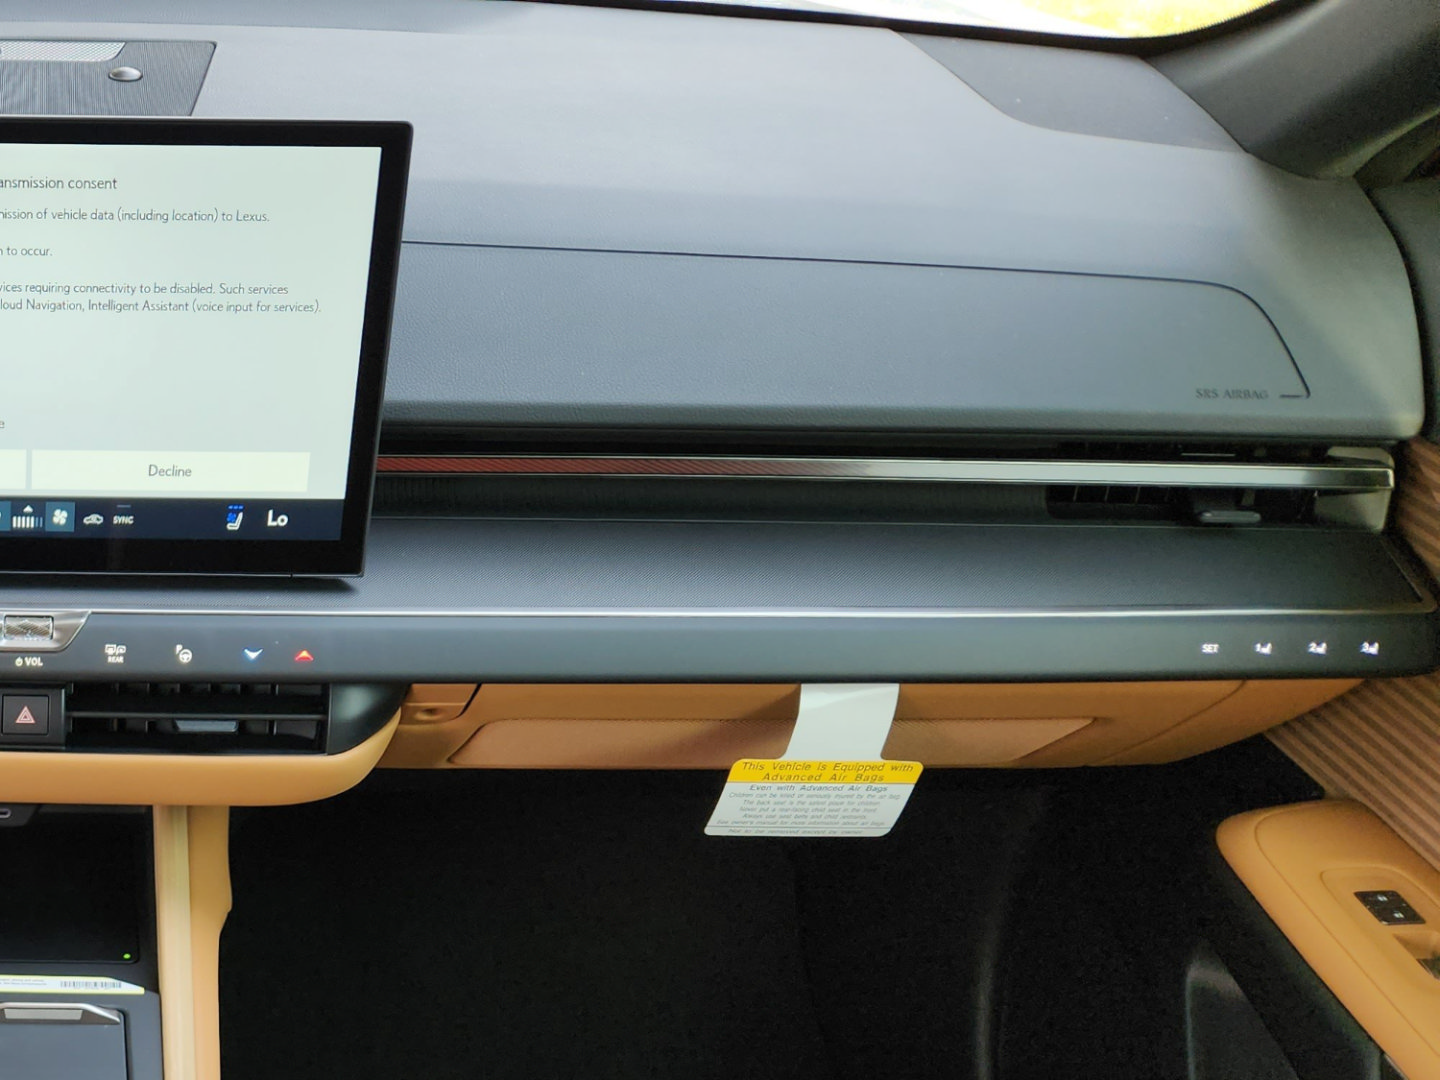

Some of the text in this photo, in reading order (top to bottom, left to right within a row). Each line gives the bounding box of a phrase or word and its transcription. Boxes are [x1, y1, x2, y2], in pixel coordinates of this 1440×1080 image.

[68, 178, 117, 190] consent
[36, 208, 48, 220] of
[51, 209, 87, 220] vehicle
[90, 209, 114, 220] data
[117, 206, 169, 223] (including
[172, 207, 219, 223] location)
[222, 212, 232, 222] to
[236, 210, 270, 222] Lexus.
[6, 246, 18, 256] to
[21, 247, 53, 256] occur.
[25, 283, 70, 296] requiring
[73, 284, 137, 296] connectivity
[140, 285, 151, 294] to
[154, 284, 167, 294] be
[170, 283, 215, 295] disabled.
[219, 283, 245, 295] Such
[248, 285, 289, 295] services
[26, 300, 85, 313] Navigation,
[88, 300, 139, 313] Intelligent
[142, 300, 189, 312] Assistant
[192, 300, 223, 313] (voice
[227, 302, 253, 314] input
[256, 301, 270, 312] for
[274, 300, 322, 313] services).
[1196, 389, 1269, 399] SRS AIRBAG
[148, 464, 192, 477] Decline
[113, 515, 134, 525] SYNC
[268, 510, 289, 527] Lo
[1202, 643, 1219, 654] SET
[24, 657, 43, 667] VOL
[742, 762, 914, 773] This Vehicle is Equipped with
[761, 773, 885, 783] Advanced Air Bags
[750, 784, 772, 792] Even
[800, 784, 844, 792] Advanced
[865, 785, 888, 793] Bags
